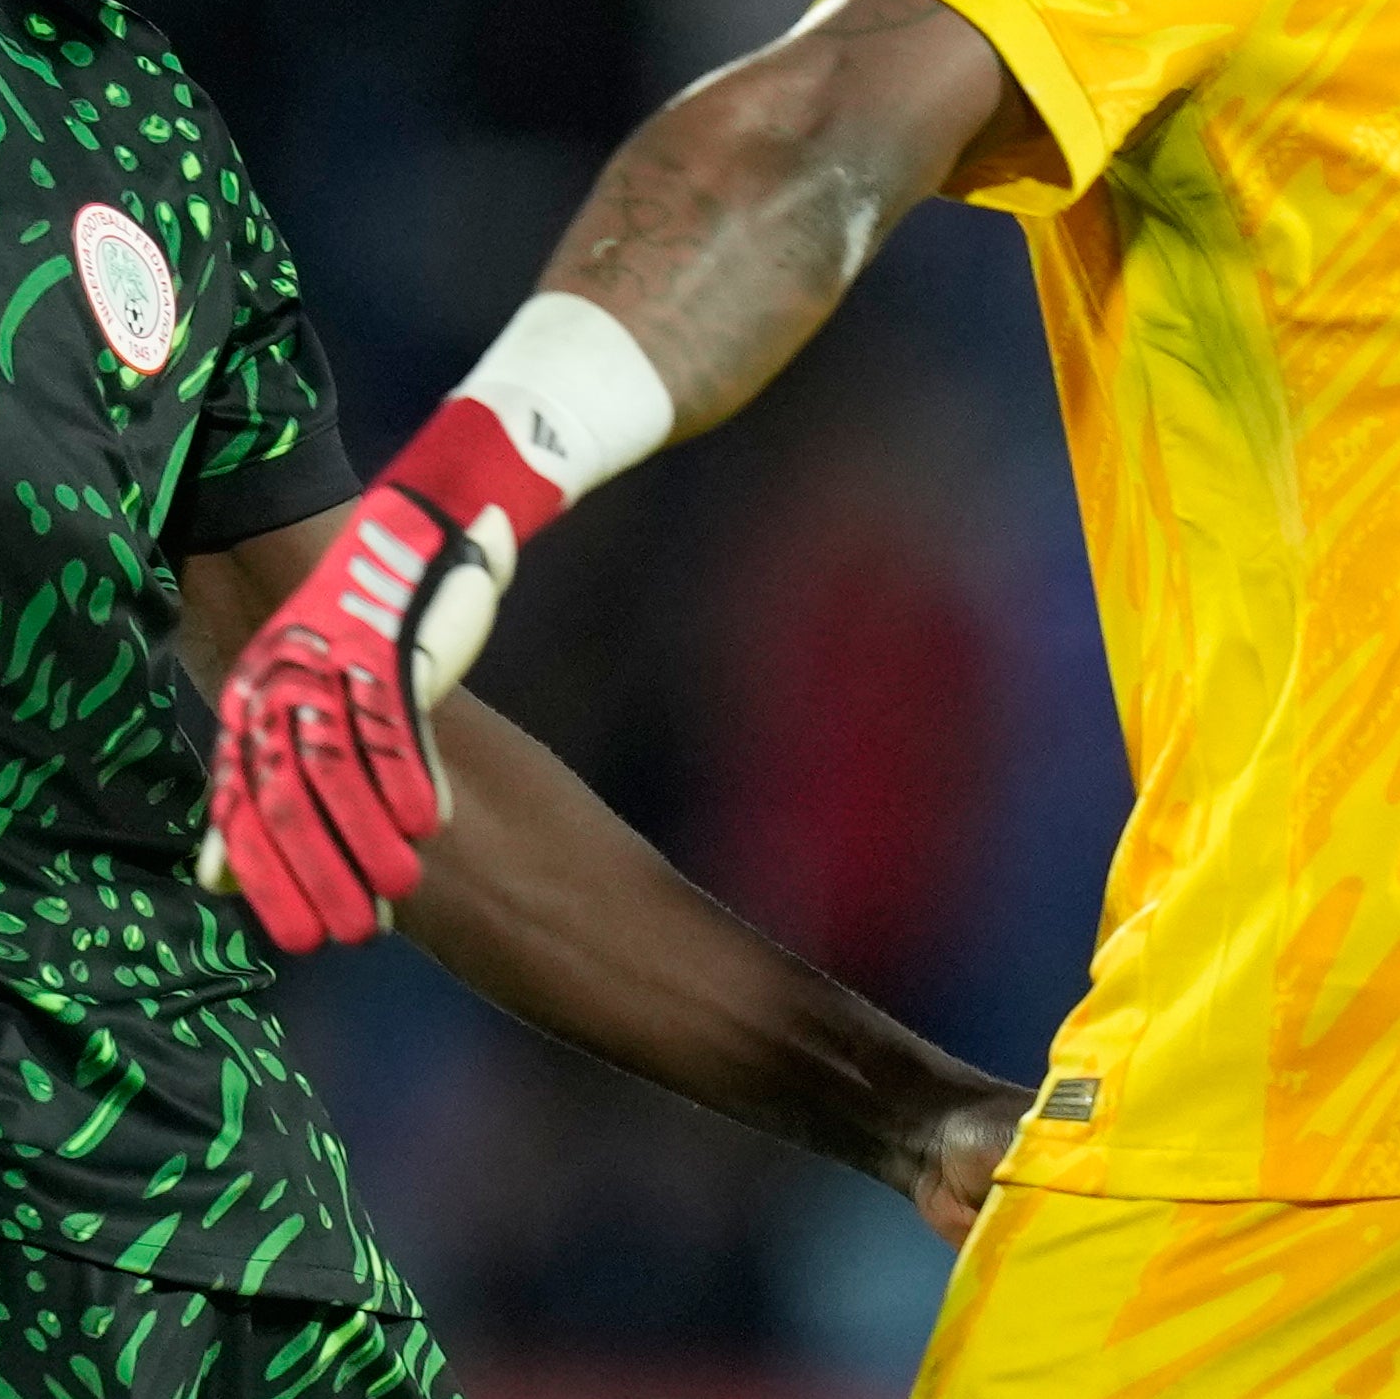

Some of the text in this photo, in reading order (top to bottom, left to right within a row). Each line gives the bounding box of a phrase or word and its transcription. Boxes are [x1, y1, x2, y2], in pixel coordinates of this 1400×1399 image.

[80, 211, 171, 345] NIGERIA FOOTBALL FEDERATION
[127, 340, 152, 363] 1945
